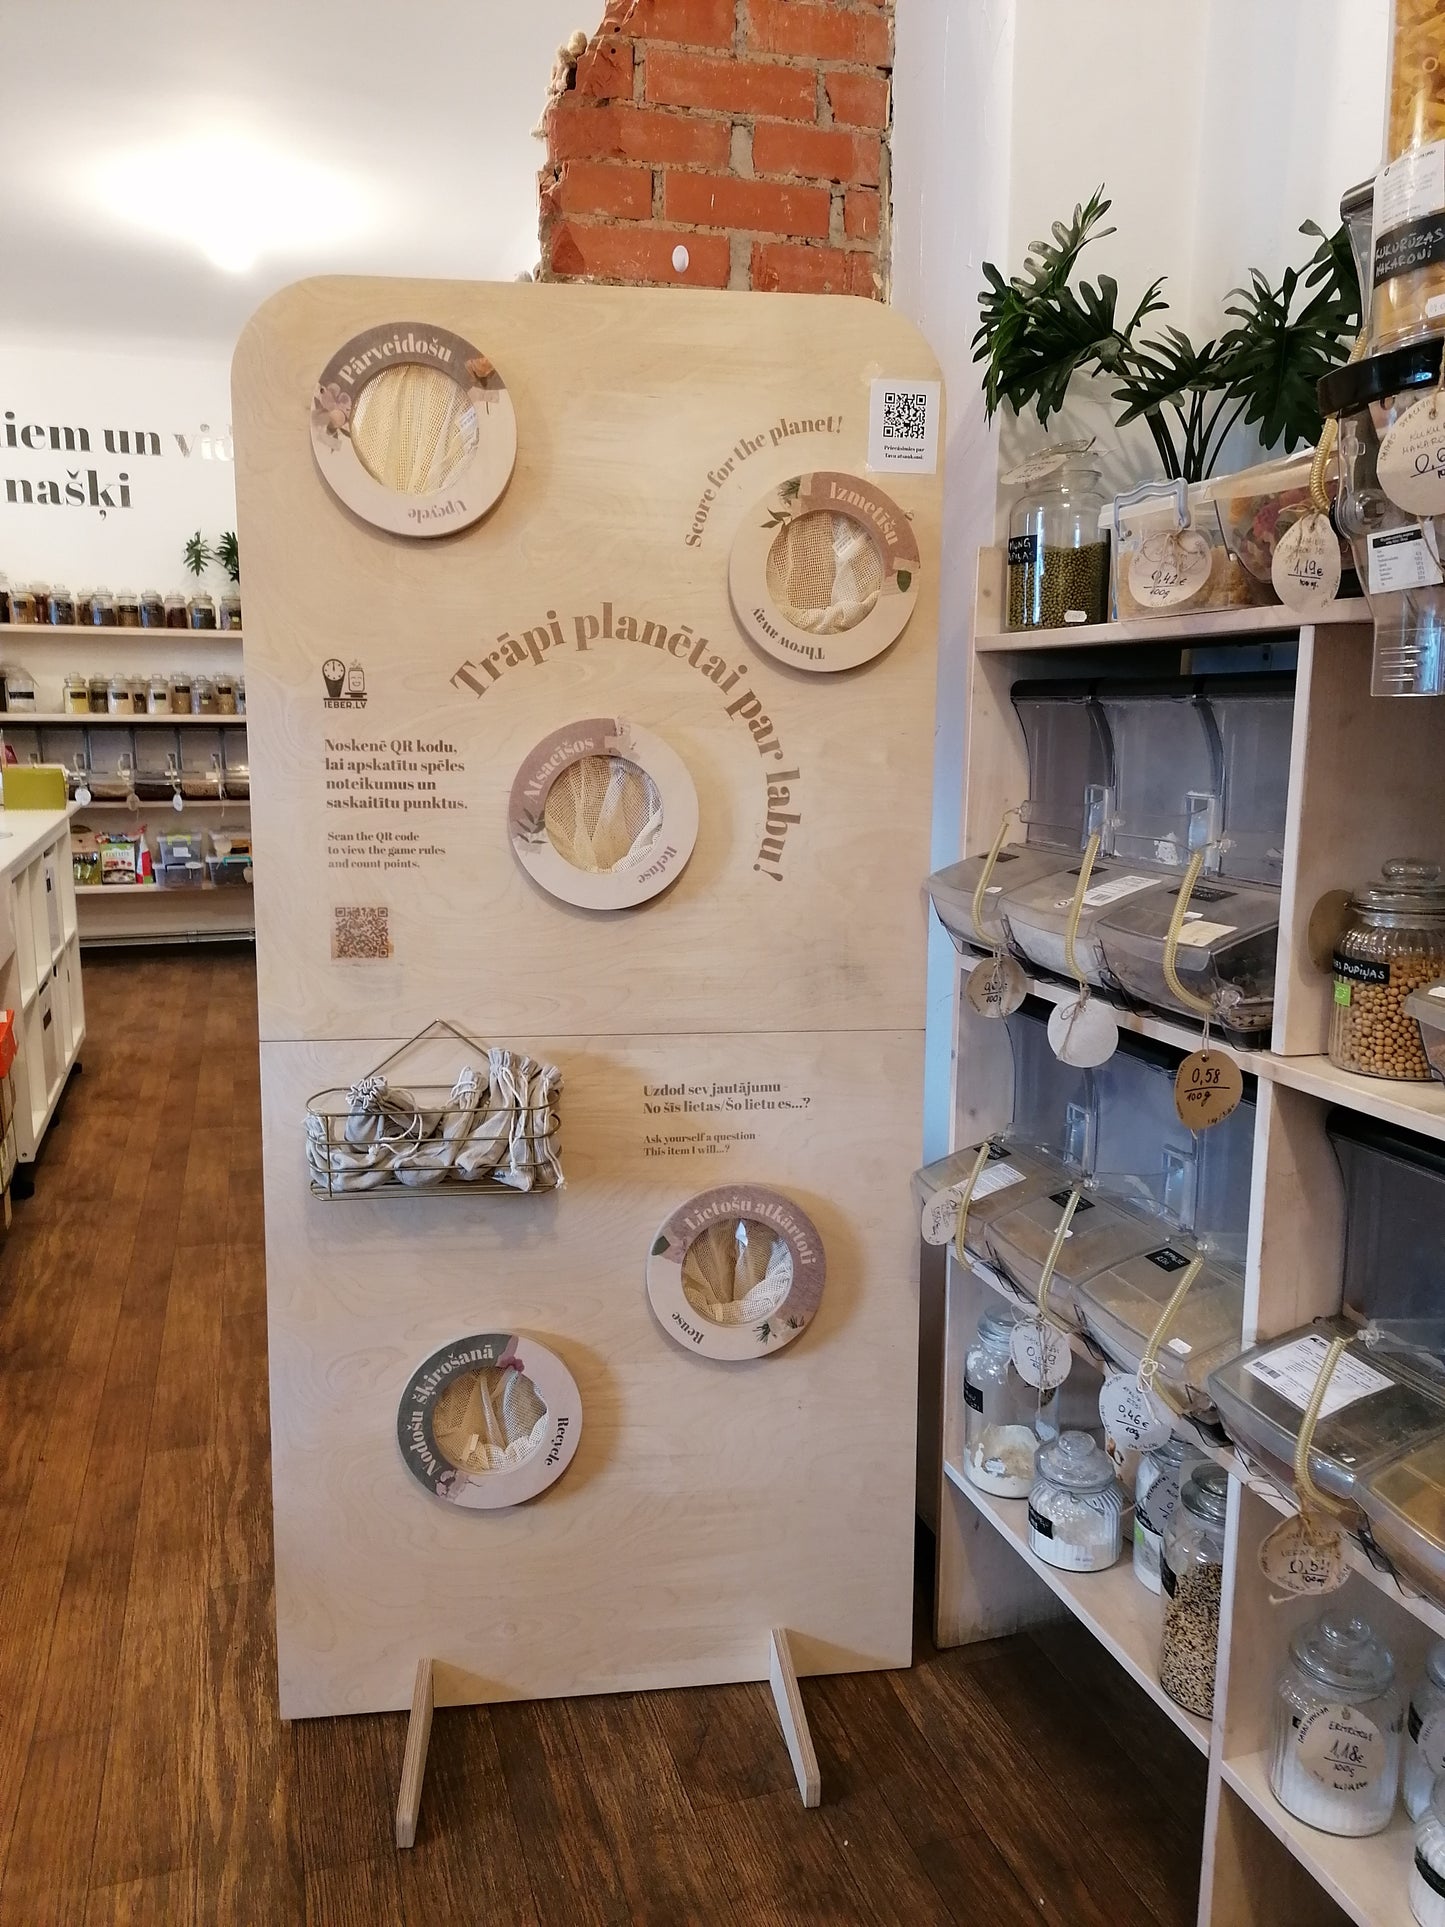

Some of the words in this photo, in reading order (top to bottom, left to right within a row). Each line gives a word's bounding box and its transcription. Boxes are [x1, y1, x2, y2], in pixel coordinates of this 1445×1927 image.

[338, 333, 453, 386] Pārveidošu
[0, 411, 92, 453] iem
[103, 428, 163, 457] un
[1409, 421, 1445, 442] KUKU
[5, 468, 134, 521] našķi
[685, 489, 717, 549] Score
[707, 455, 738, 490] for
[733, 432, 768, 462] the
[768, 415, 844, 448] planet!
[408, 499, 468, 524] Upcycle
[828, 481, 899, 548] Izmetīšu
[751, 607, 779, 640] away
[449, 609, 567, 700] Trāpi
[572, 601, 749, 696] planētai
[778, 635, 825, 661] Throw
[324, 700, 367, 709] IEBER.LV
[723, 687, 785, 762] par
[325, 738, 387, 753] Noskenē
[390, 740, 413, 755] QR
[416, 739, 457, 754] kodu,
[325, 758, 344, 771] lai
[347, 758, 417, 774] apskatītu
[420, 759, 465, 775] spēles
[523, 735, 595, 806] Atsacīšos
[326, 777, 414, 790] noteikumus
[417, 779, 436, 791] un
[326, 796, 400, 809] saskaitītu
[403, 797, 468, 812] punktus.
[327, 831, 354, 842] Scan
[355, 831, 374, 841] the
[375, 831, 393, 843] QR
[394, 831, 420, 842] code
[752, 766, 802, 883] labu!
[327, 845, 340, 855] to
[341, 845, 366, 855] view
[368, 845, 387, 855] the
[388, 846, 417, 857] game
[418, 845, 446, 855] rules
[328, 859, 349, 869] and
[351, 859, 381, 869] count
[383, 859, 420, 870] points.
[638, 845, 678, 885] Refuse
[643, 1083, 685, 1097] Uzdod
[688, 1085, 708, 1096] sev
[709, 1081, 781, 1098] jautājumu
[1191, 1067, 1221, 1086] 0,58
[643, 1102, 661, 1114] No
[663, 1101, 681, 1113] šīs
[683, 1097, 742, 1113] lietas/Šo
[744, 1098, 775, 1110] lietu
[777, 1097, 811, 1110] es...?
[643, 1135, 662, 1144] Ask
[663, 1132, 705, 1146] yourself
[713, 1132, 756, 1144] question
[644, 1147, 666, 1156] This
[667, 1146, 690, 1156] item
[692, 1146, 696, 1155] I
[684, 1197, 752, 1231] Lietošu
[755, 1201, 817, 1266] atkārtoti
[672, 1312, 705, 1345] Reuse
[412, 1344, 494, 1405] šķirošanā
[407, 1410, 441, 1477] Nodošu
[545, 1416, 569, 1466] Recycle
